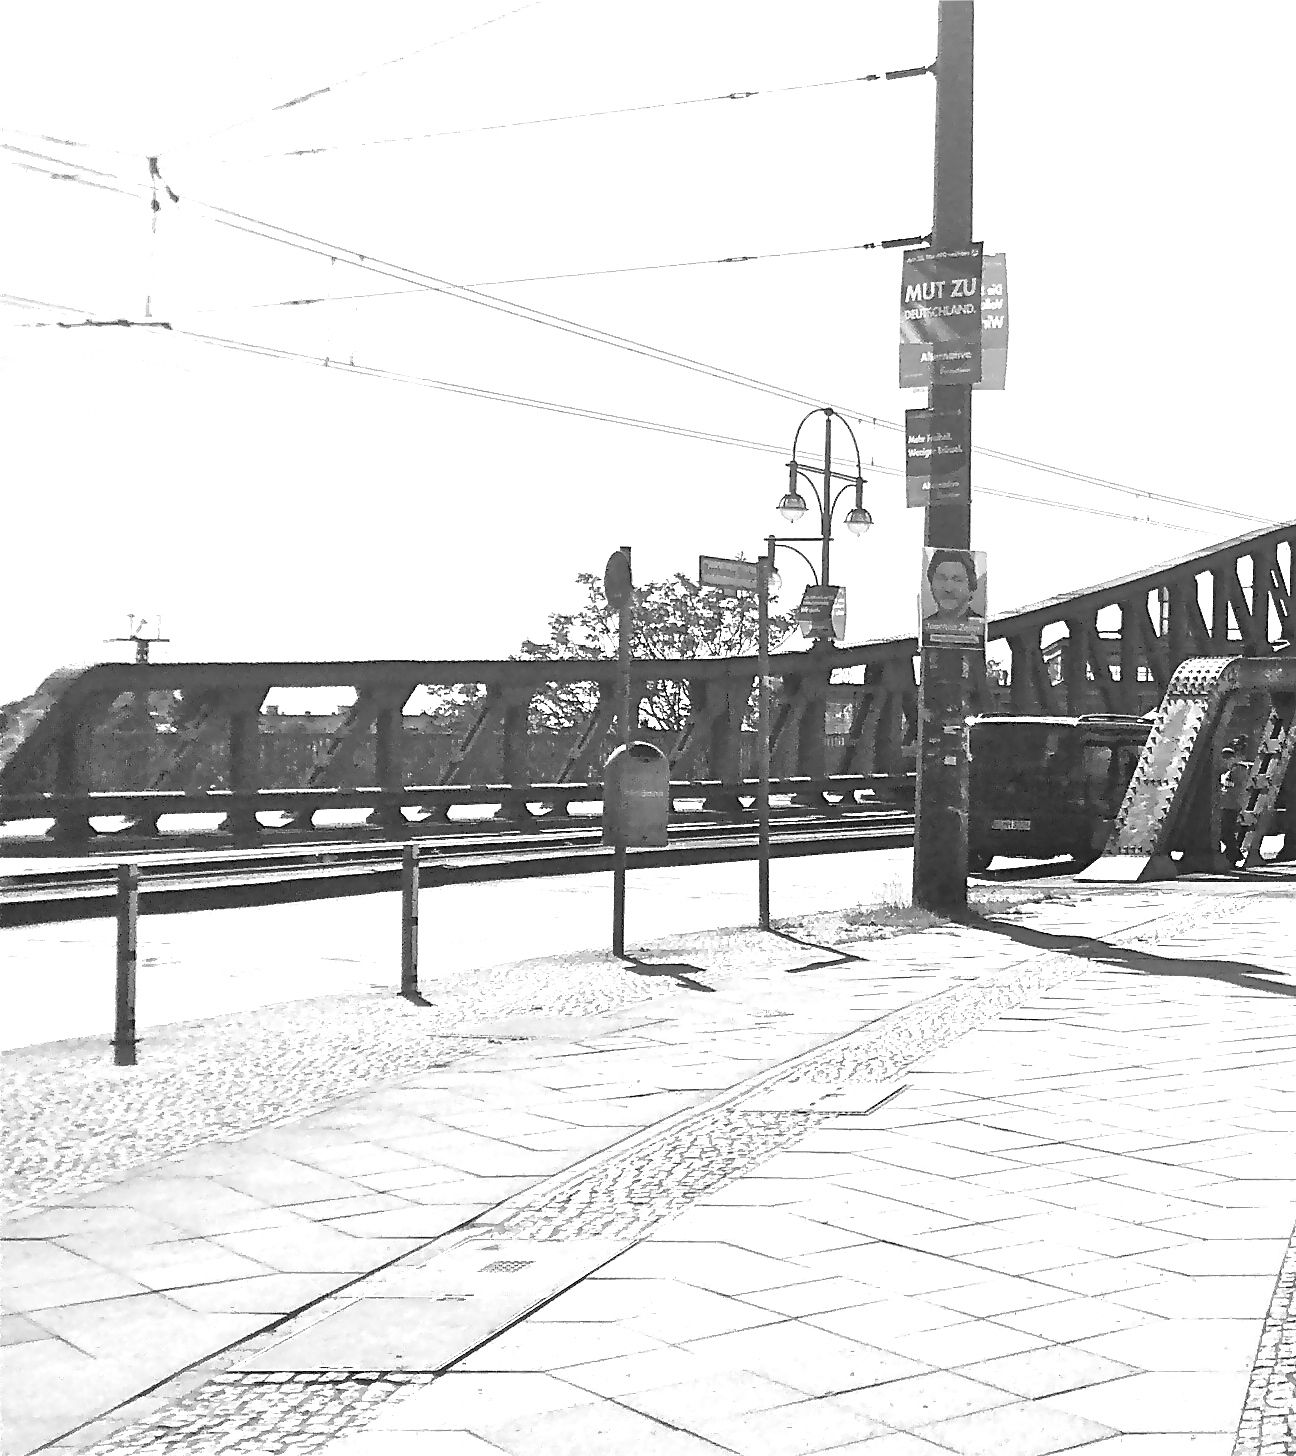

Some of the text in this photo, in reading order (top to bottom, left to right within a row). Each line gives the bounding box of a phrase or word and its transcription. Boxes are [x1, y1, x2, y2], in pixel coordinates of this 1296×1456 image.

[905, 277, 977, 302] MUT ZU
[904, 304, 976, 320] DEUTSCHLAND.
